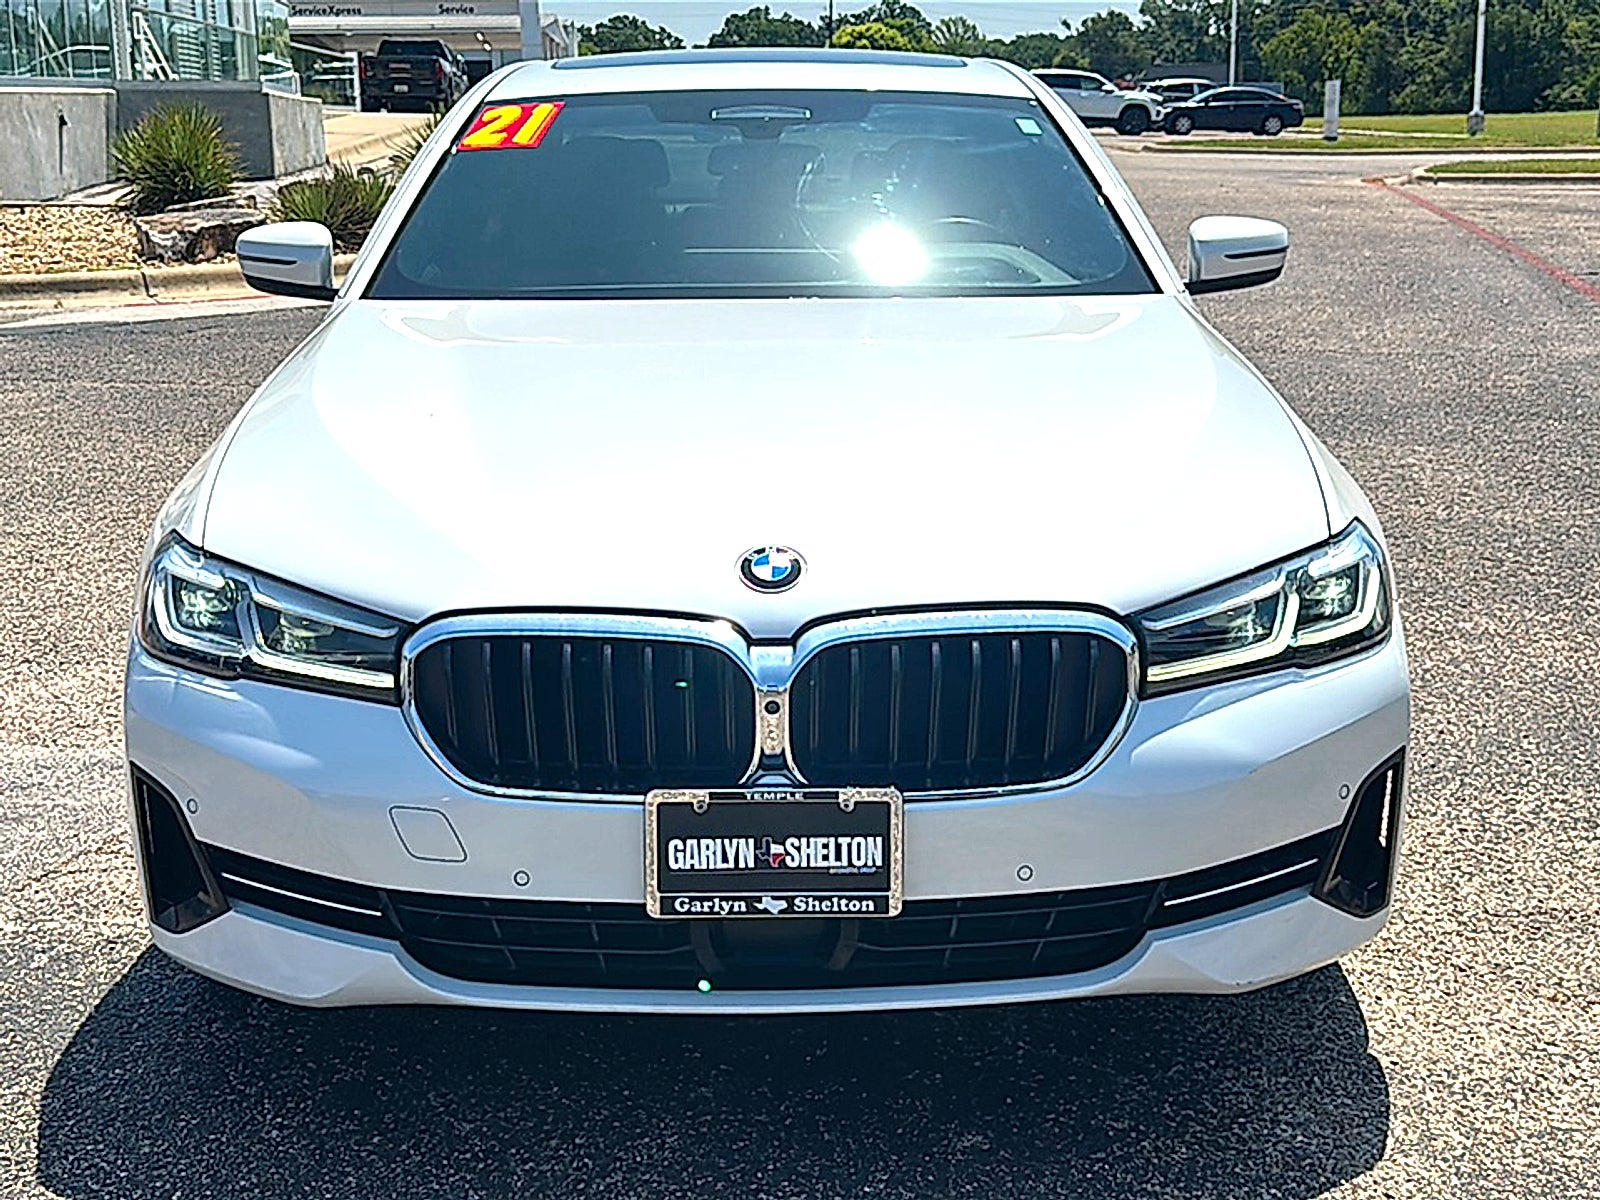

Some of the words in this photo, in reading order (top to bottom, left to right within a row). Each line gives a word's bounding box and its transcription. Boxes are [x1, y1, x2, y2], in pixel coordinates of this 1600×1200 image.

[438, 4, 475, 15] Service
[462, 103, 557, 146] 21
[744, 791, 805, 801] TEMPLE
[668, 837, 755, 869] GARLYN
[785, 836, 883, 868] SHELTON
[674, 897, 747, 915] Garlyn
[793, 896, 875, 912] Shelton
